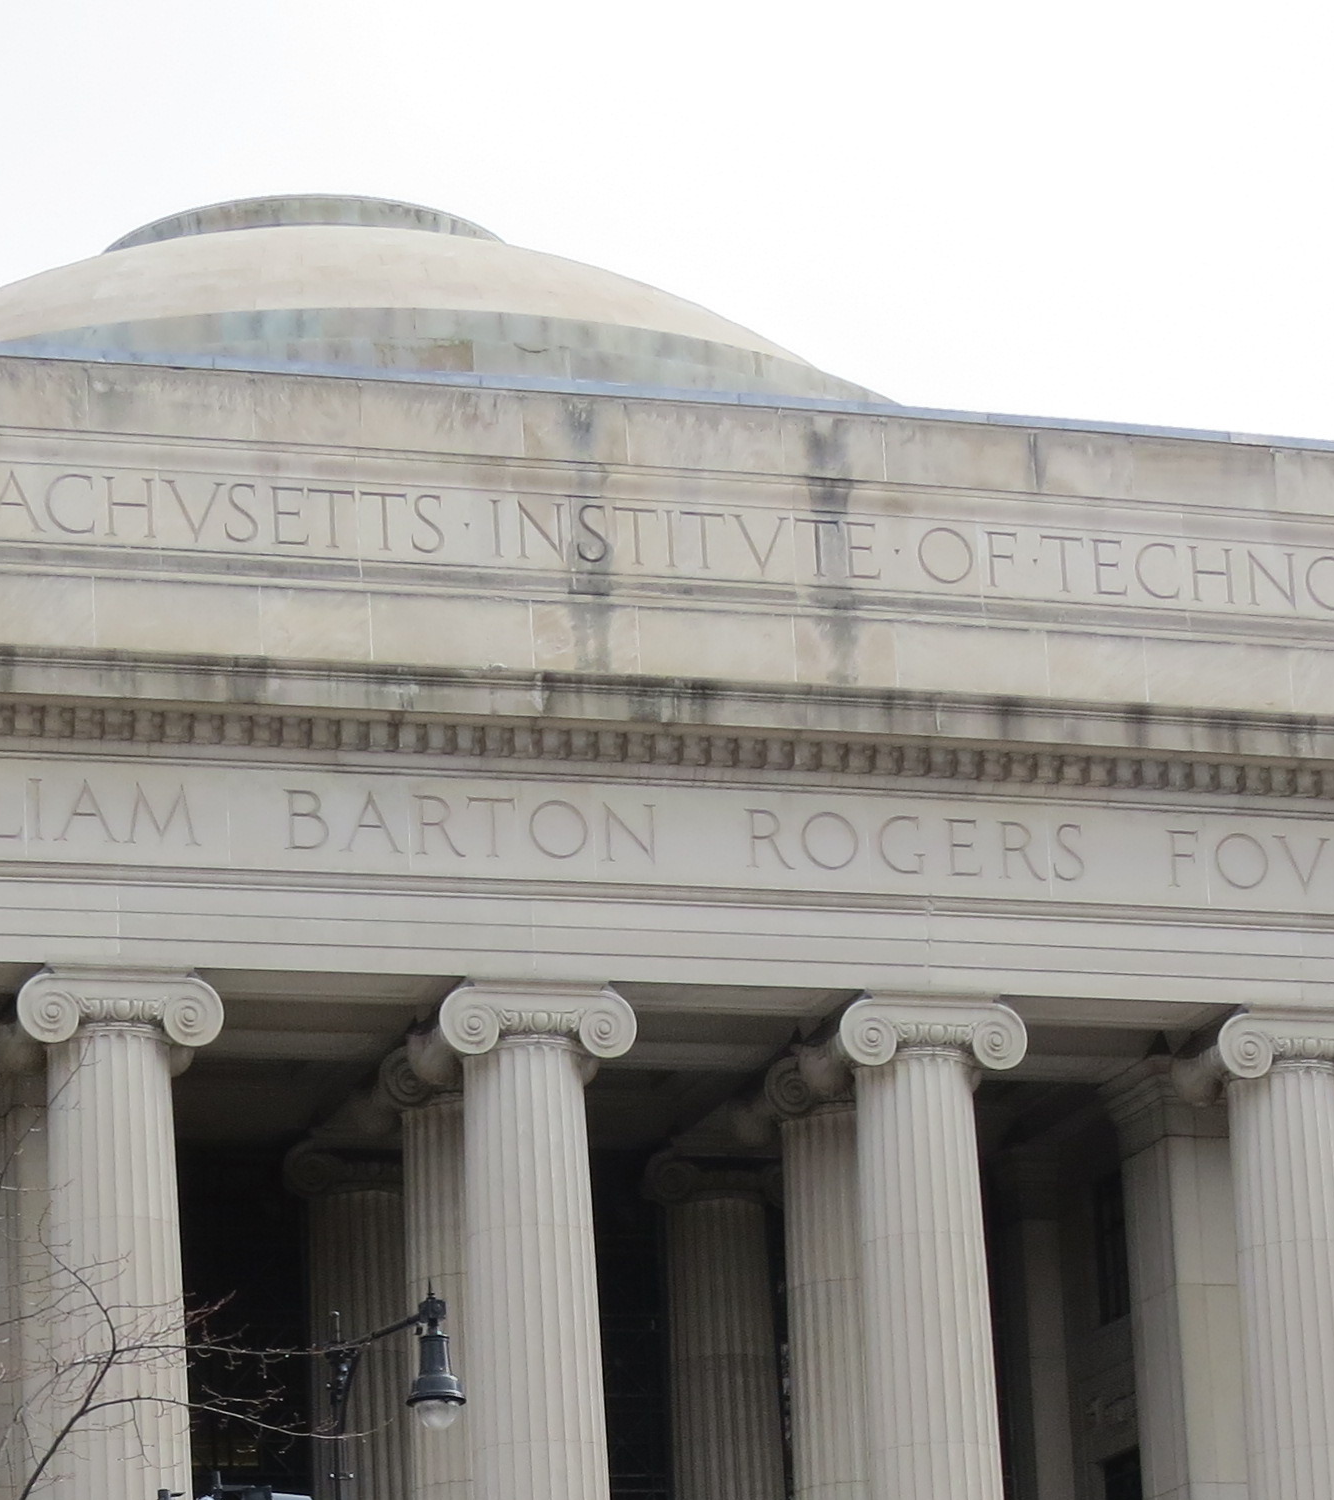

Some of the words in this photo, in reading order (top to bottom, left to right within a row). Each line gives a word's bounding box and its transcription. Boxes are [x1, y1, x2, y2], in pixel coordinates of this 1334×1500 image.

[492, 497, 881, 583] INSTITVTE
[917, 526, 1017, 589] OF
[283, 786, 657, 864] BARTON
[743, 808, 1086, 882] ROGERS
